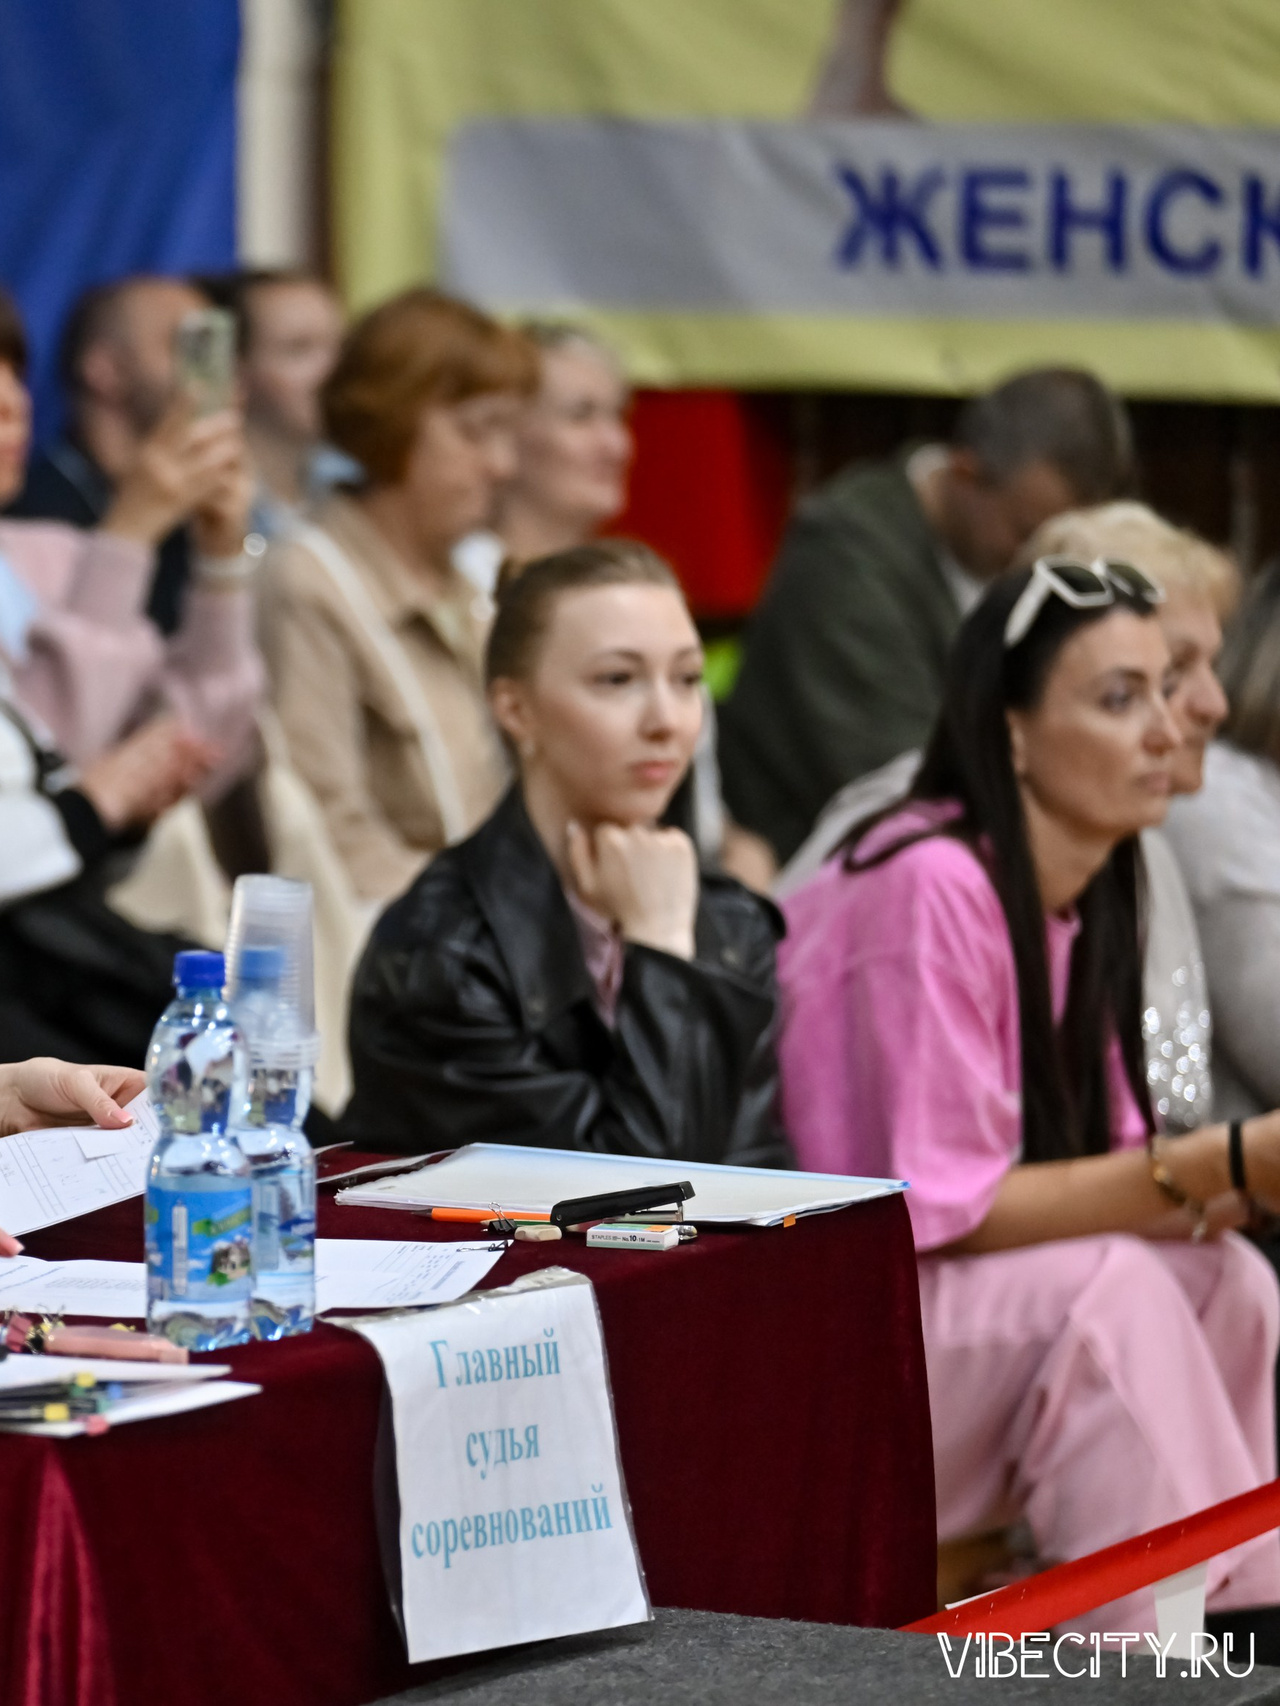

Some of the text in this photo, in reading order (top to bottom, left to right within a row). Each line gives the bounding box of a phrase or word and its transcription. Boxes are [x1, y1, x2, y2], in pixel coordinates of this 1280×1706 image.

[428, 1327, 561, 1389] Главный
[466, 1424, 540, 1480] судья
[411, 1483, 614, 1570] соревнований
